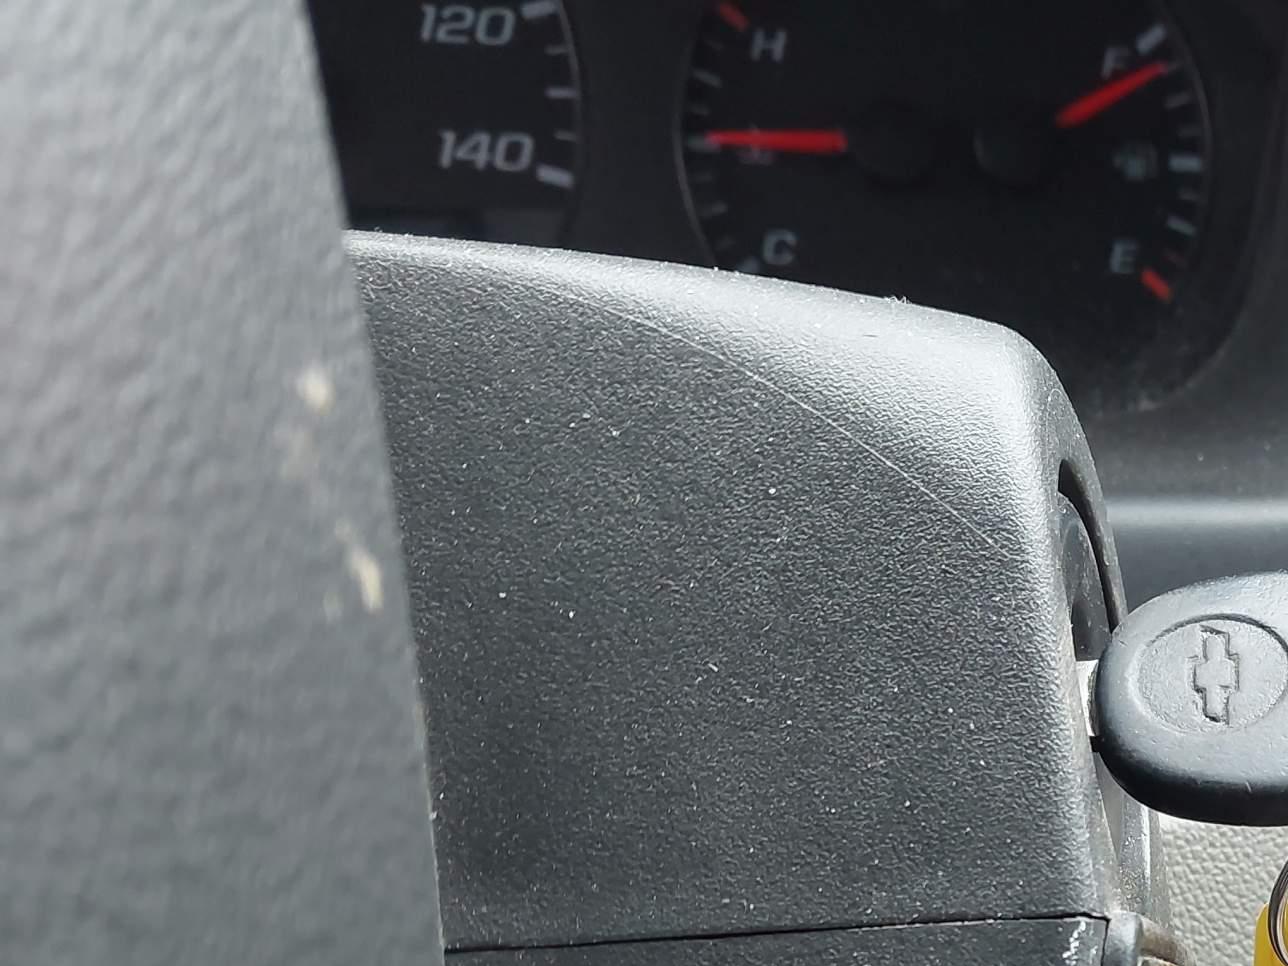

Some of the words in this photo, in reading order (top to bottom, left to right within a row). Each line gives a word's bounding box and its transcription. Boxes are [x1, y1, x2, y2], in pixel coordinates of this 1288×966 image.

[420, 3, 516, 46] 120
[752, 28, 787, 62] H
[438, 129, 534, 172] 140
[762, 229, 797, 265] C
[1110, 240, 1137, 274] E
